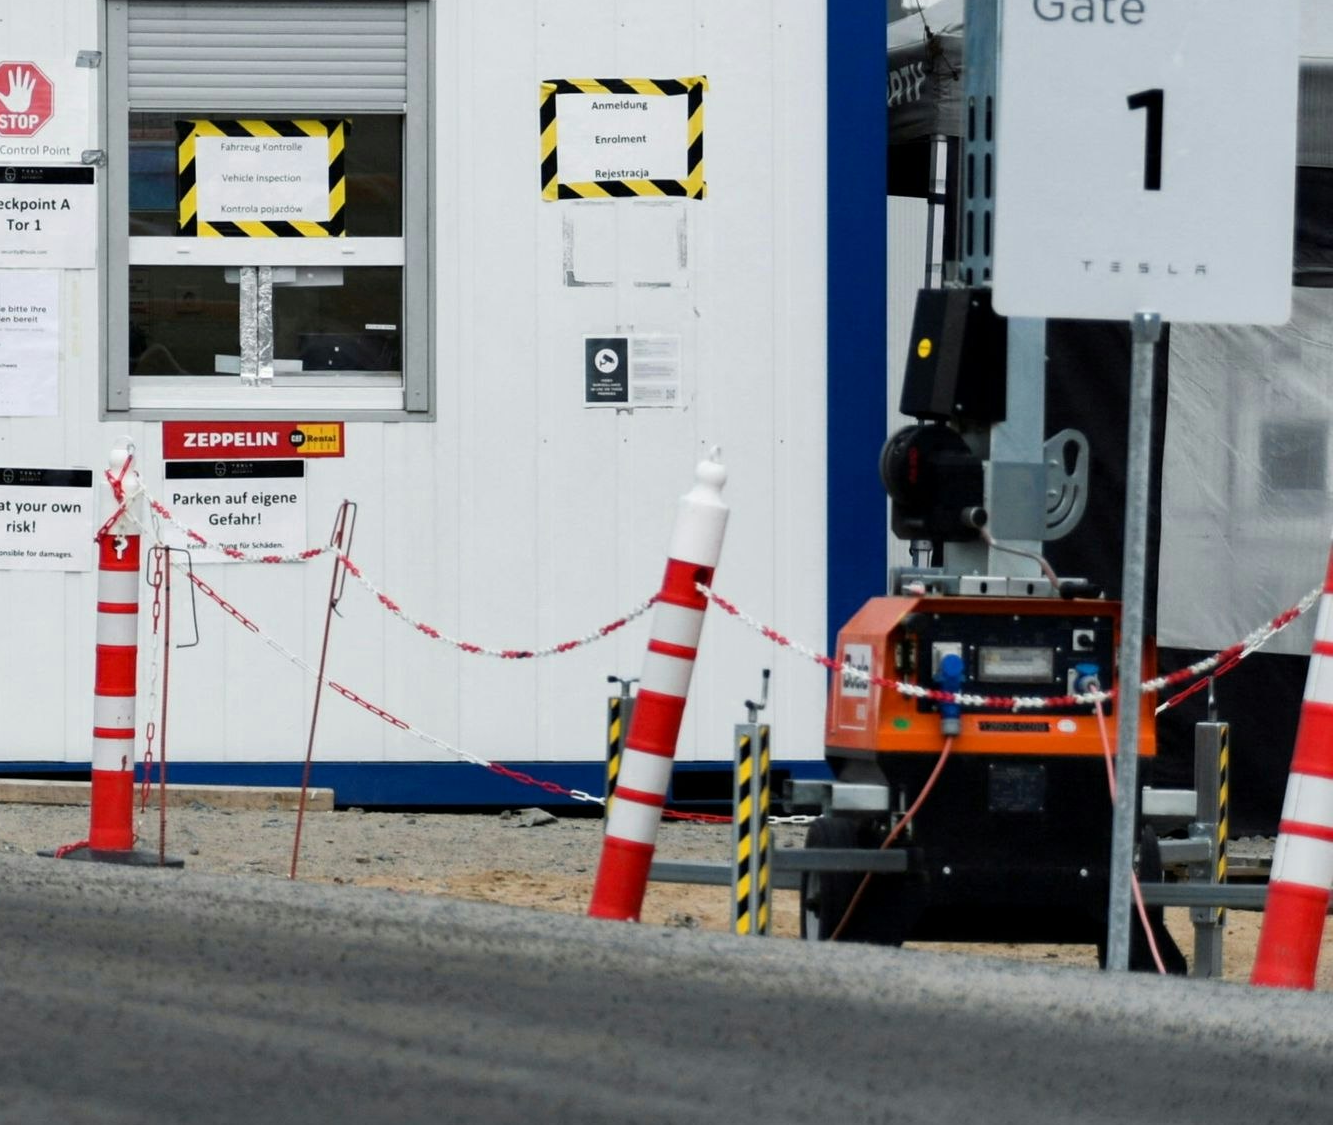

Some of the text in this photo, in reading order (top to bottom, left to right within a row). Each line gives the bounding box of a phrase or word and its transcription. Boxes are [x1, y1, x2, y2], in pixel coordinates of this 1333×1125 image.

[592, 100, 648, 110] Anmeldung
[595, 135, 647, 144] Enrolment
[1126, 88, 1165, 192] 1
[0, 145, 40, 155] Control
[43, 146, 71, 156] Point
[220, 142, 303, 153] Fahrzeug Kontrolle
[221, 174, 254, 182] Vehicle
[595, 169, 649, 179] Rejestracja
[61, 198, 71, 211] A
[221, 205, 303, 215] Kontrola pojazdów
[7, 219, 42, 231] Tor 1
[1081, 259, 1209, 277] TESLA
[8, 305, 28, 313] bitte
[183, 431, 279, 447] ZEPPELIN
[306, 434, 336, 443] Rental
[173, 492, 297, 507] Parken auf eigene
[15, 503, 47, 514] your
[51, 504, 82, 513] own
[209, 513, 262, 526] Gefahr!
[6, 521, 36, 533] risk!
[252, 541, 284, 549] Schäden.
[26, 549, 37, 557] for
[38, 550, 73, 559] damages.
